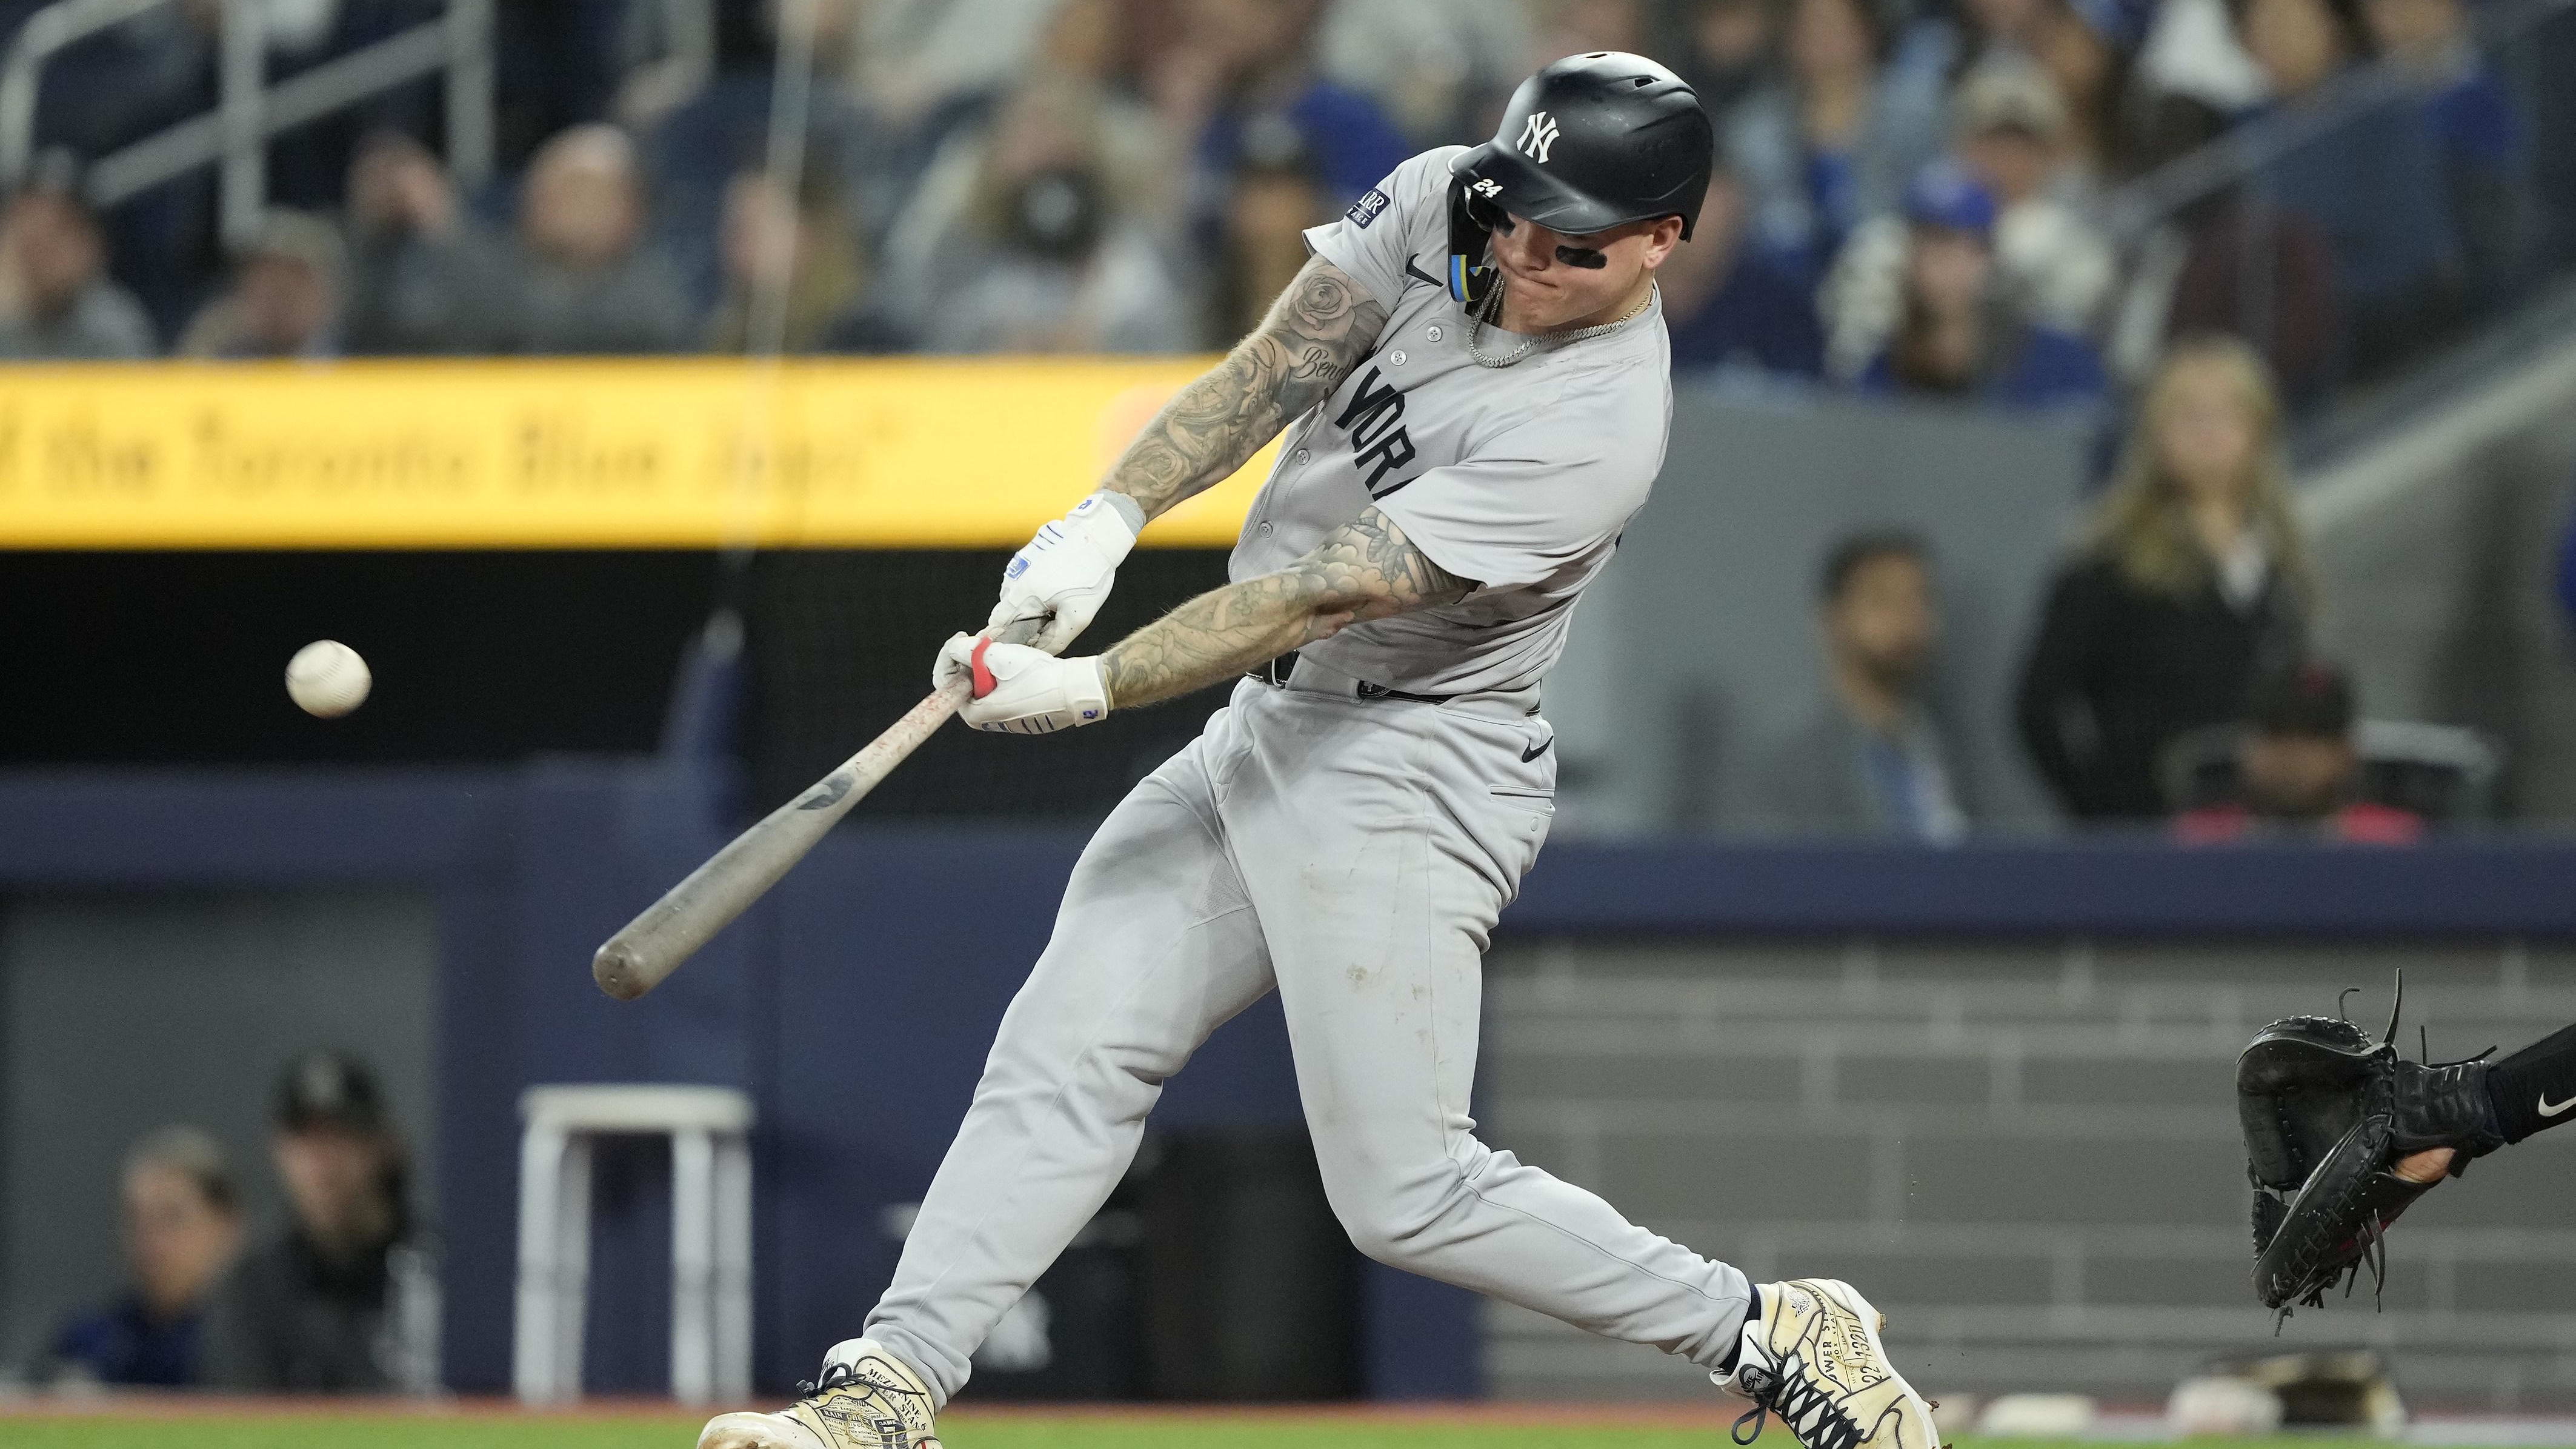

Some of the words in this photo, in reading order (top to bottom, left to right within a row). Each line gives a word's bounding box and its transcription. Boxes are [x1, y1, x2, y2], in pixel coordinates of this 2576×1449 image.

[1517, 112, 1560, 164] NY
[1473, 178, 1503, 198] 24
[1334, 365, 1421, 502] YOR
[824, 1410, 843, 1419] RAIN
[867, 1368, 922, 1419] MEZZNINE
